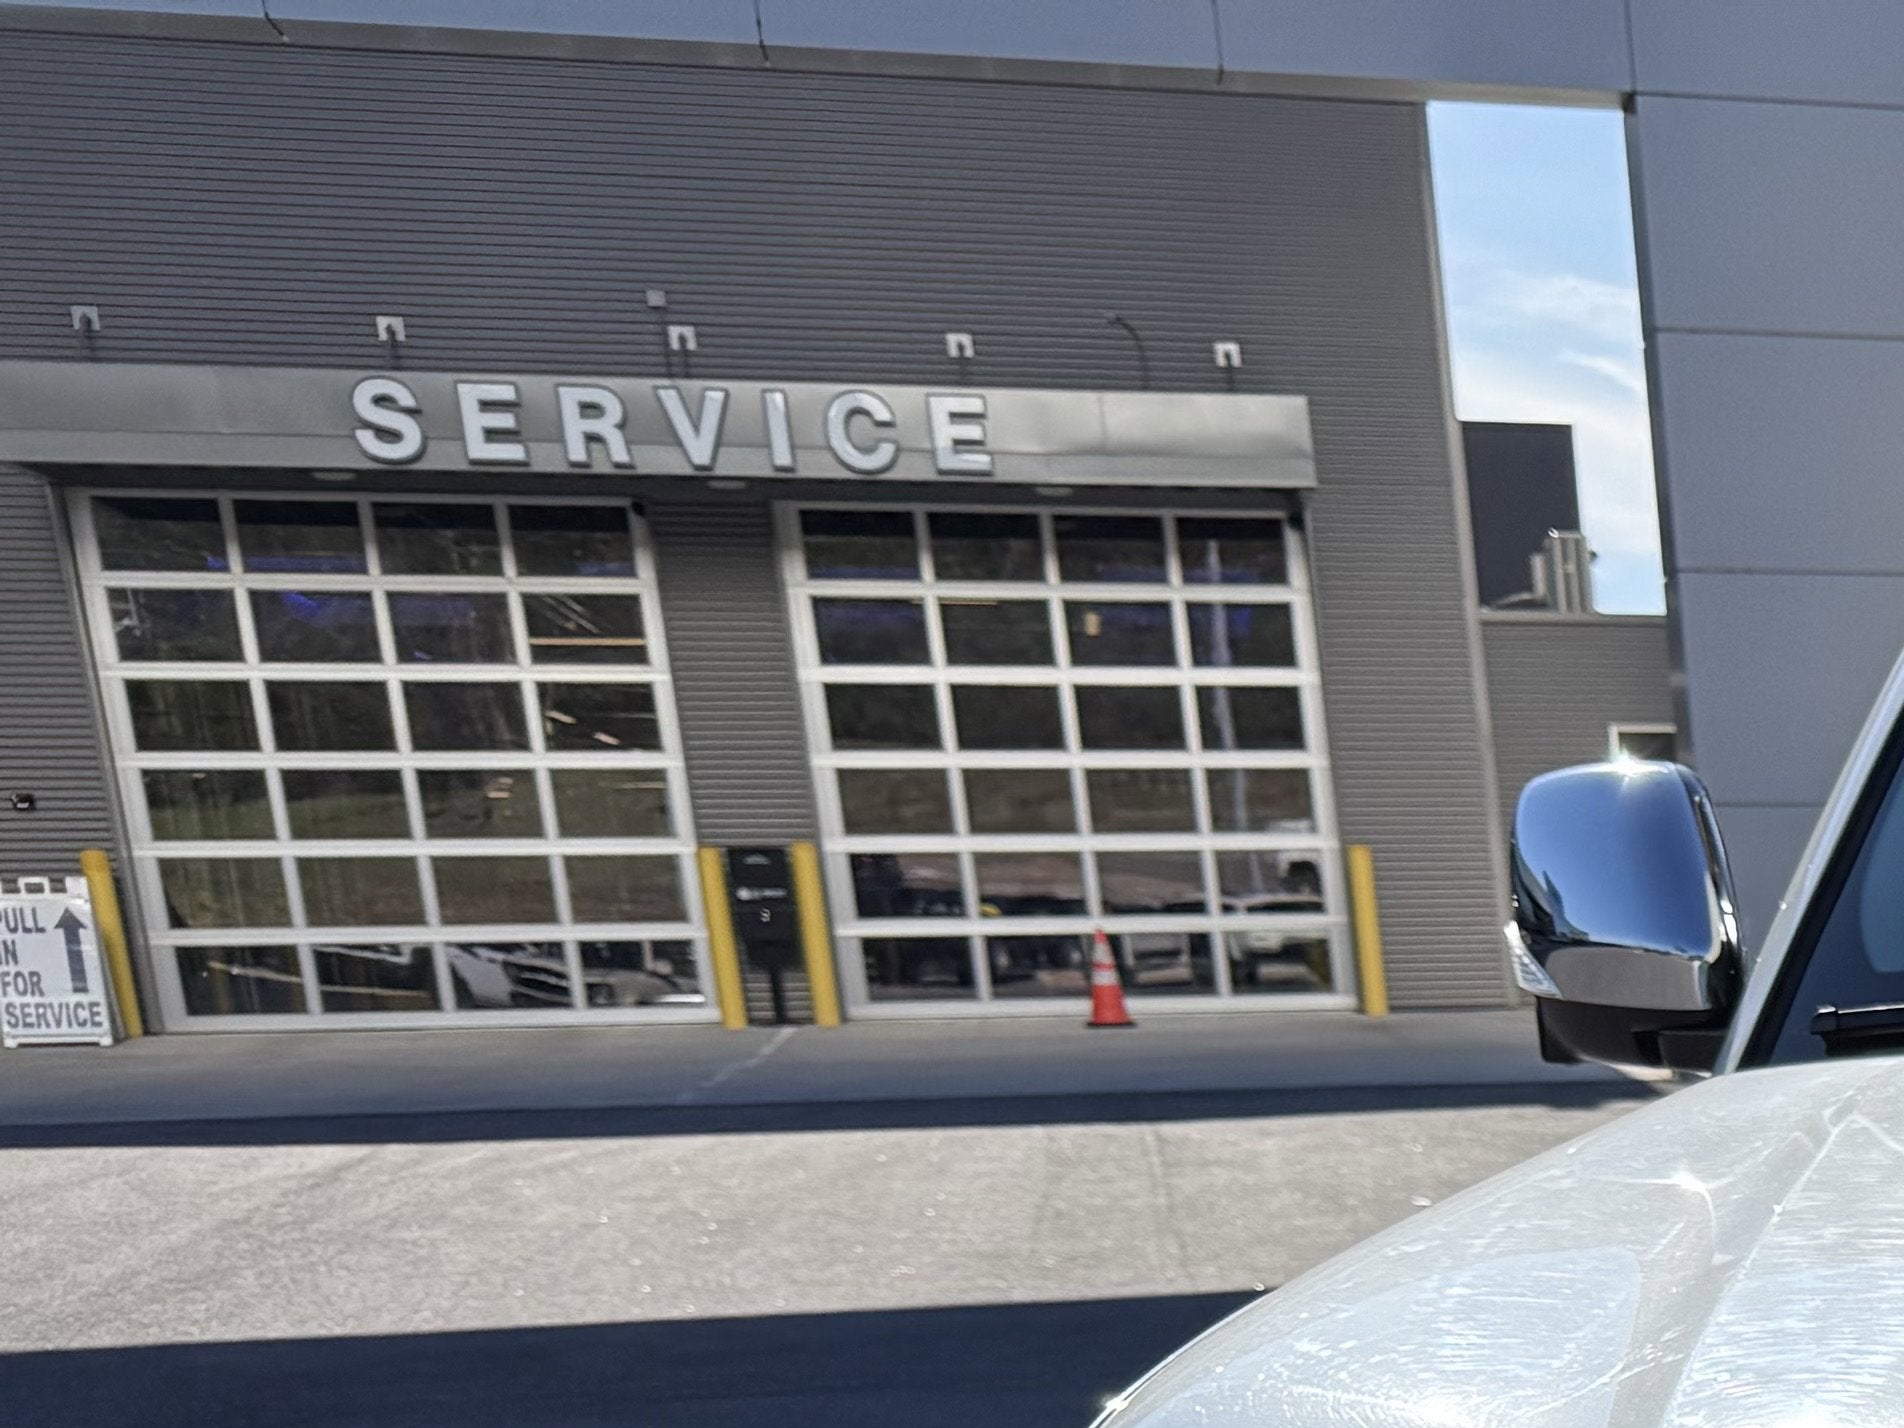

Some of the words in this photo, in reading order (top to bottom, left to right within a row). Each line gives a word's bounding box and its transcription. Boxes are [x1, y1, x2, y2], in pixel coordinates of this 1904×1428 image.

[350, 376, 994, 477] SERVICE
[1, 971, 45, 997] FOR
[5, 1002, 103, 1029] SERVICE
